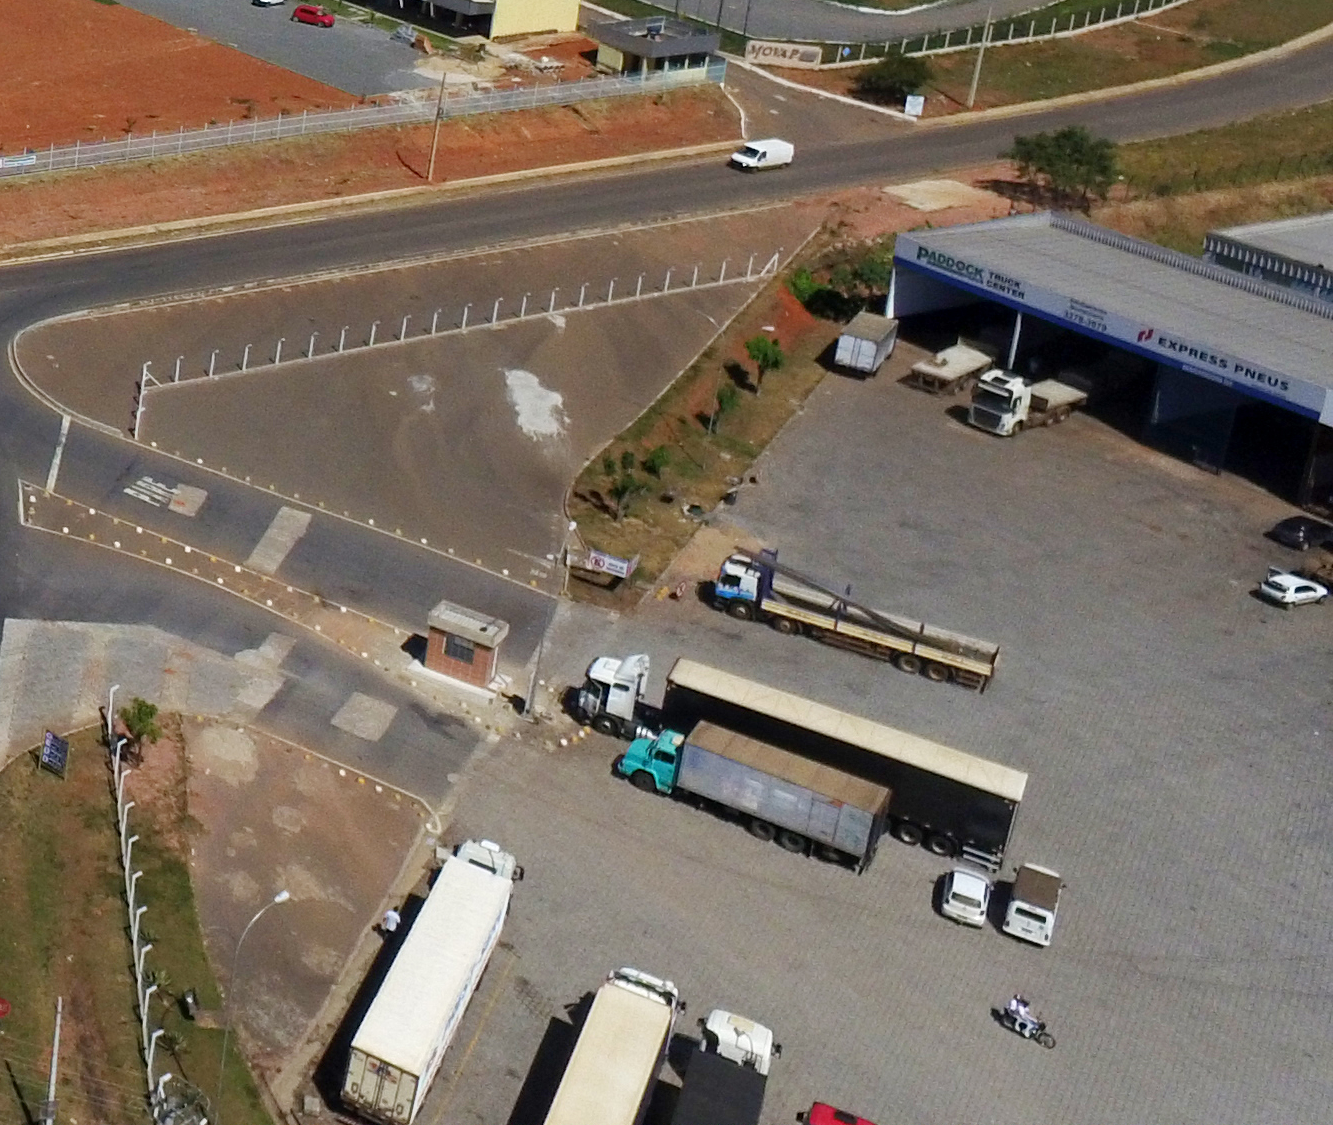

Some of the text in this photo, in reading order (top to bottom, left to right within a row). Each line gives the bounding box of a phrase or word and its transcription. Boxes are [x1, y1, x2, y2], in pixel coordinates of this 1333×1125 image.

[917, 246, 984, 280] PADDOCK
[988, 271, 1023, 290] TRUCK
[986, 279, 1026, 300] CENTER
[1158, 337, 1229, 370] EXPRESS
[1234, 362, 1290, 392] PNEUS
